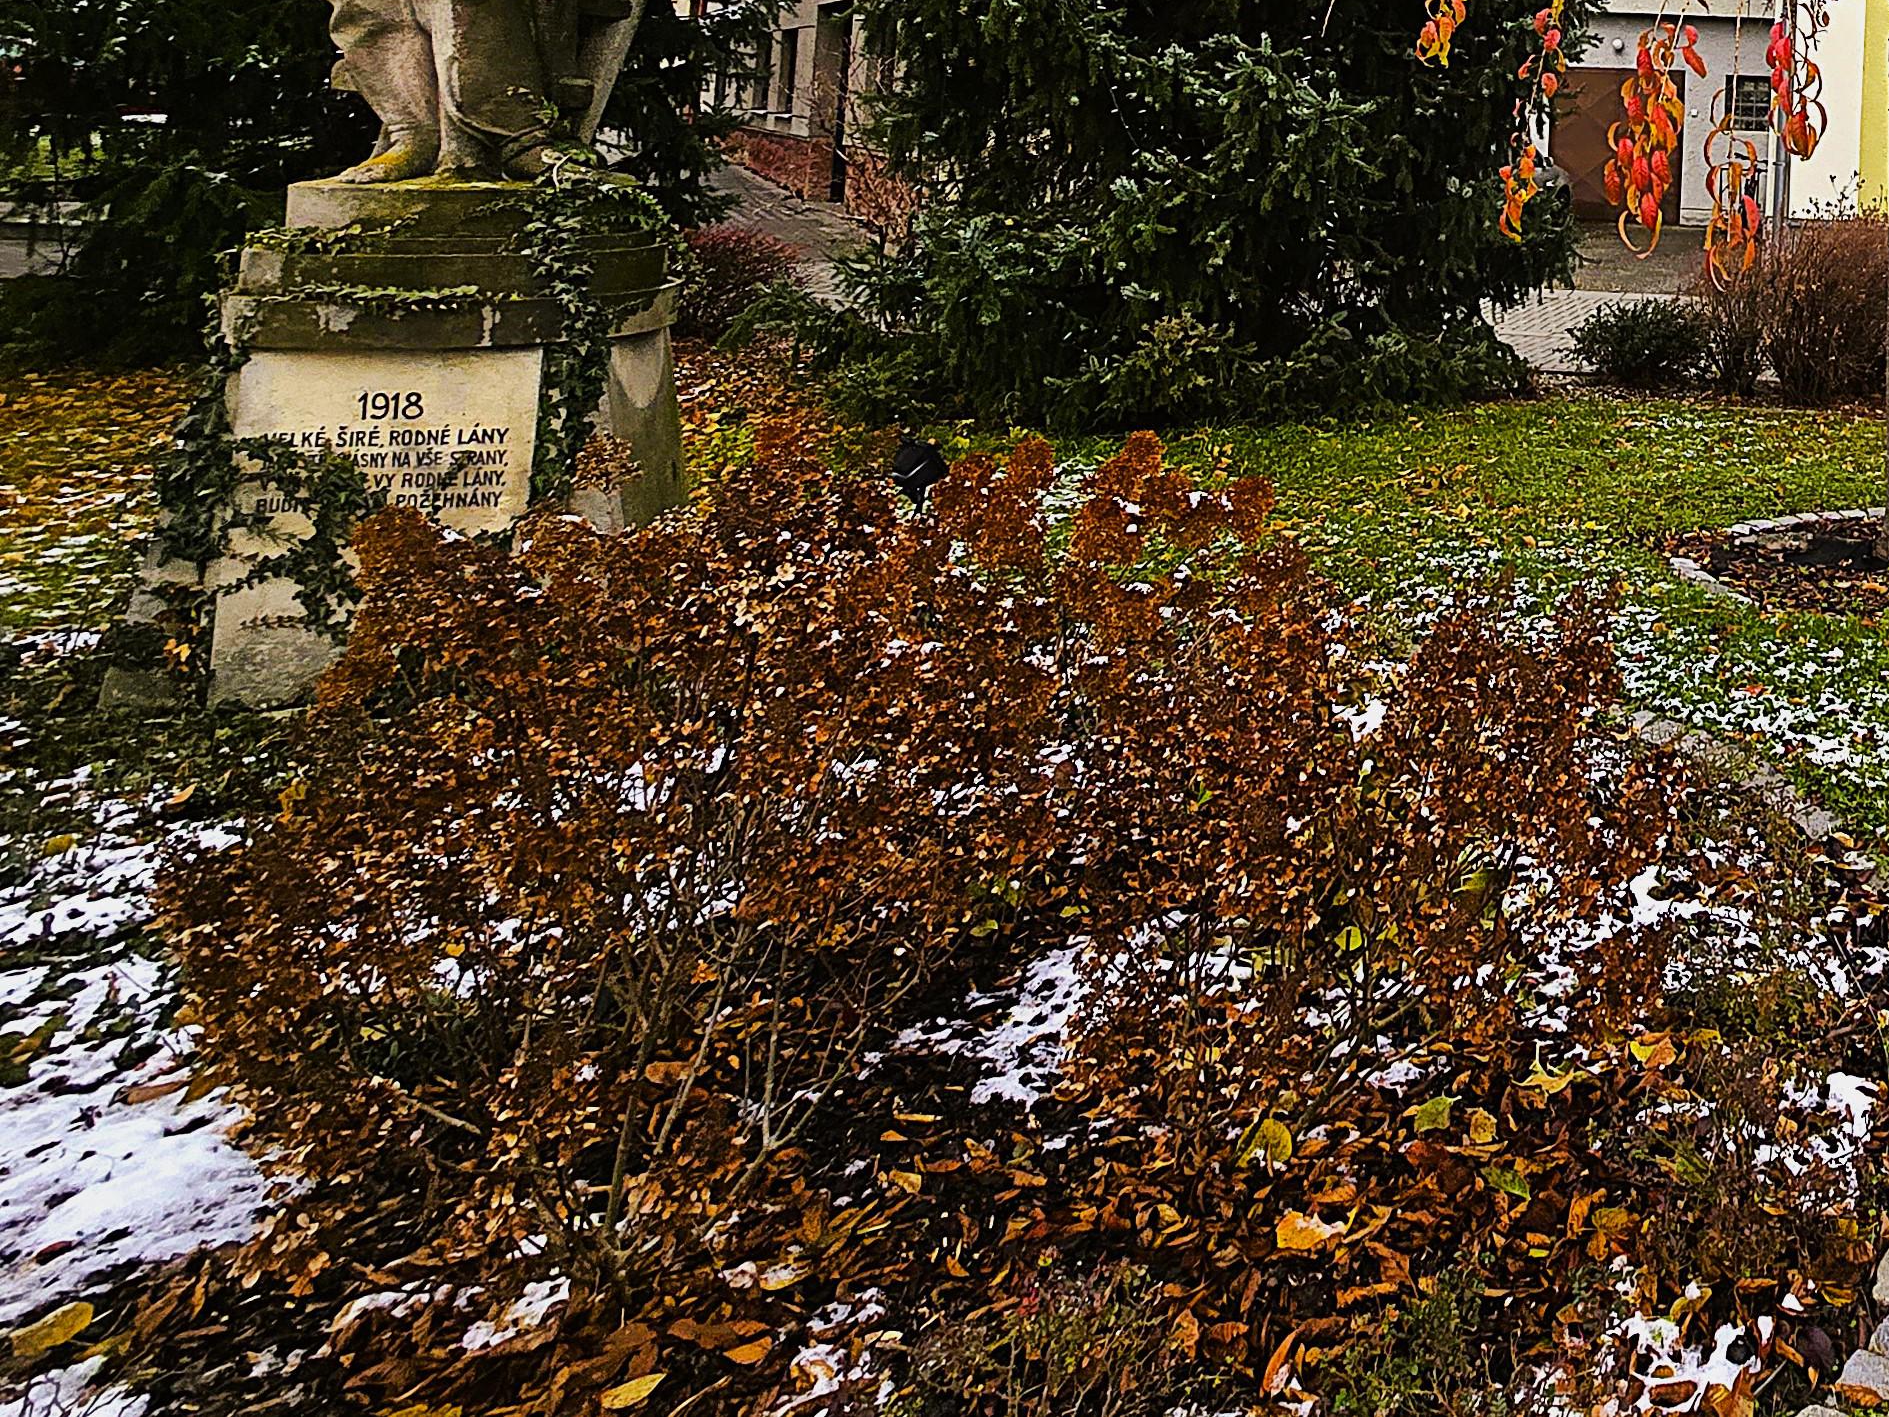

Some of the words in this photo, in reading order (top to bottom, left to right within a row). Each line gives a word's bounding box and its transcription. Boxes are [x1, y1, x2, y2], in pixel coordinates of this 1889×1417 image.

[358, 391, 424, 421] 1918
[389, 424, 451, 446] RODNÉ
[458, 423, 510, 445] LÁNY
[338, 449, 388, 468] ÁSNY
[392, 451, 411, 468] NA
[416, 447, 443, 467] VŠE
[373, 474, 396, 488] VY
[463, 467, 506, 487] LÁNY,
[396, 487, 503, 508] POŽEHNÁNY
